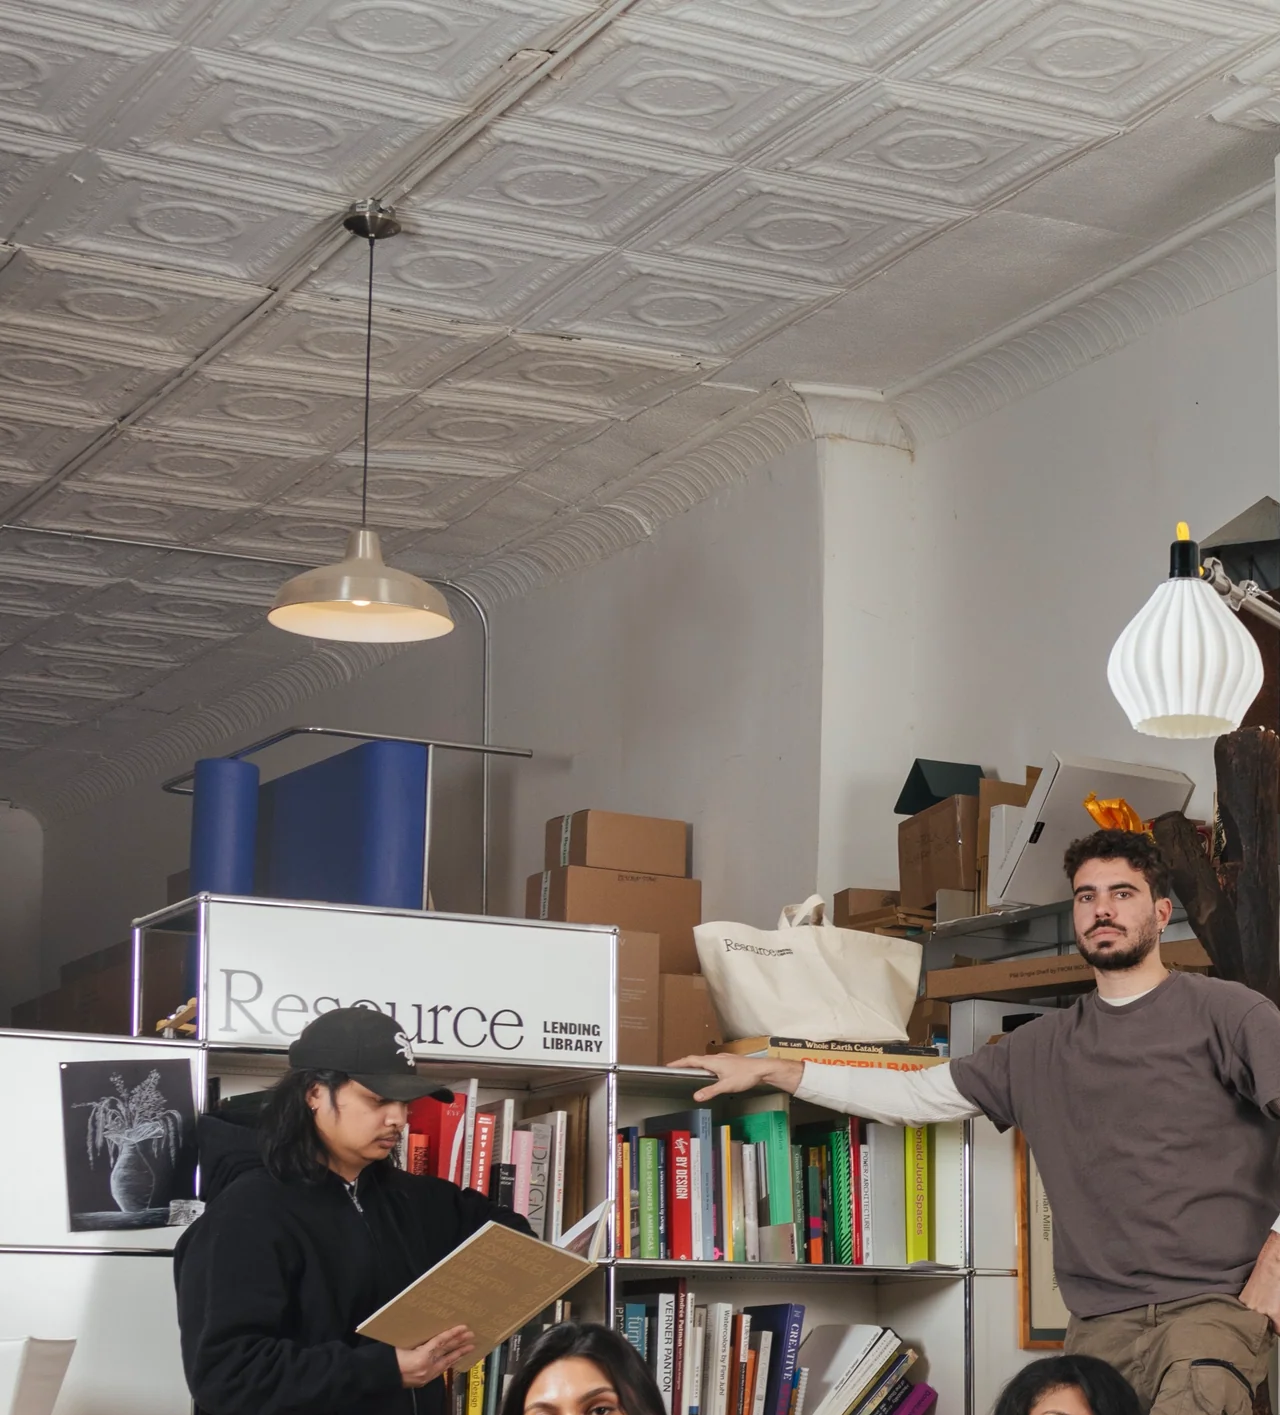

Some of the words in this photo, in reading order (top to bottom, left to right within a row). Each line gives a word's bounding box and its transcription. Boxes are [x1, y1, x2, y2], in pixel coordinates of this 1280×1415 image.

[218, 968, 524, 1050] Resurce
[543, 1020, 601, 1037] LENDING
[543, 1037, 603, 1053] LIBRARY
[805, 1041, 829, 1050] Whole
[831, 1043, 853, 1051] Earth
[854, 1045, 883, 1054] Catalog
[675, 1138, 688, 1154] Virgin
[676, 1157, 687, 1166] BY
[528, 1146, 547, 1220] DESIGN
[676, 1170, 688, 1199] DESIGN
[862, 1151, 870, 1231] POWER/ARCHITECTURE
[916, 1163, 924, 1191] Judd
[915, 1195, 924, 1235] Spaces
[664, 1300, 673, 1344] VERNER
[677, 1320, 685, 1347] Putman
[721, 1310, 729, 1354] Watercolors
[720, 1355, 727, 1363] by
[783, 1323, 799, 1380] CREATIVE
[663, 1348, 671, 1392] PANTON
[471, 1381, 480, 1408] Design
[915, 1390, 931, 1410] Donald
